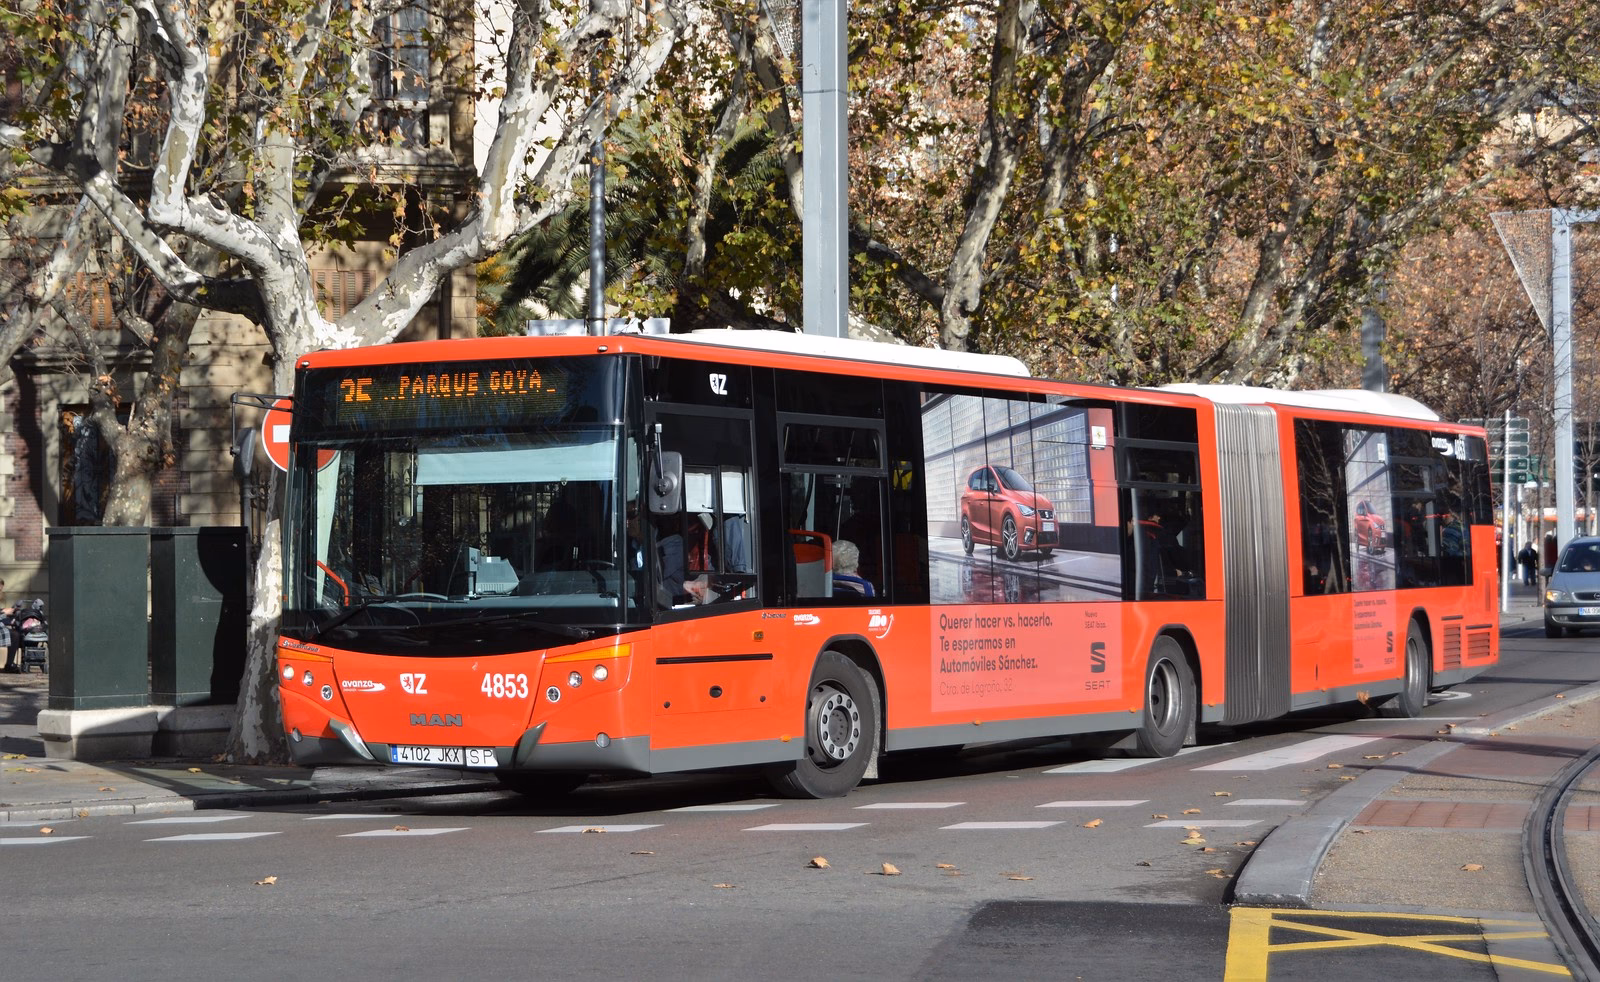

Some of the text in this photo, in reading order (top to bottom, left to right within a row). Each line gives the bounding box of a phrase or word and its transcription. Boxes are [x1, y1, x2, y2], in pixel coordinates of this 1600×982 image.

[400, 372, 479, 395] PARQUE
[489, 369, 542, 391] GOYA
[939, 611, 1053, 631] Querer hacer vs. hacerlo.
[939, 635, 1016, 655] Te esperamos en
[939, 654, 1038, 674] Automóviles Sánchez.
[341, 680, 373, 688] avanza
[480, 672, 529, 699] 4853
[961, 682, 970, 695] de
[1084, 680, 1111, 691] SEAT
[409, 713, 463, 727] MAN
[401, 746, 460, 763] 4102 JKX
